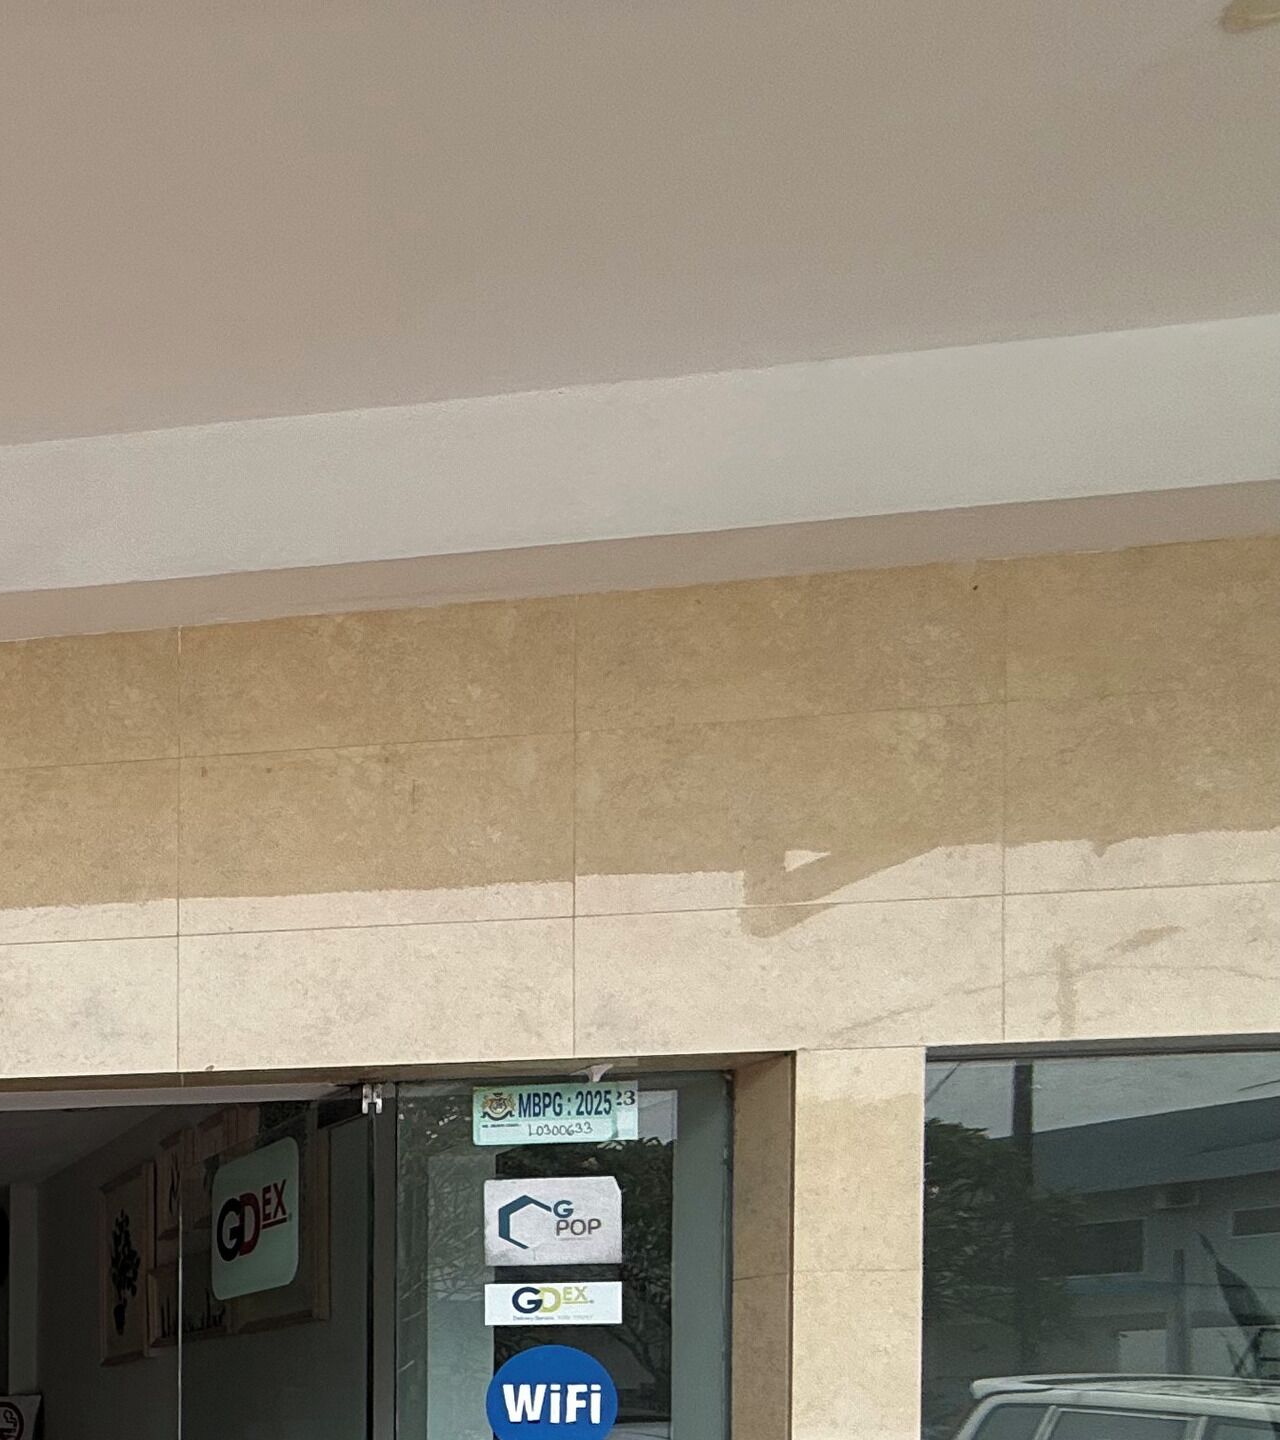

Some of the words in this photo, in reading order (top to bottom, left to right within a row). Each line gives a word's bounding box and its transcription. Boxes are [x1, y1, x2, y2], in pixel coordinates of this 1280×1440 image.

[518, 1091, 563, 1118] MBPG
[575, 1090, 612, 1116] 2025
[216, 1179, 288, 1262] GDEX
[553, 1200, 574, 1219] G
[556, 1218, 602, 1236] POP
[512, 1286, 588, 1314] GDEX
[502, 1384, 601, 1424] WiFi
